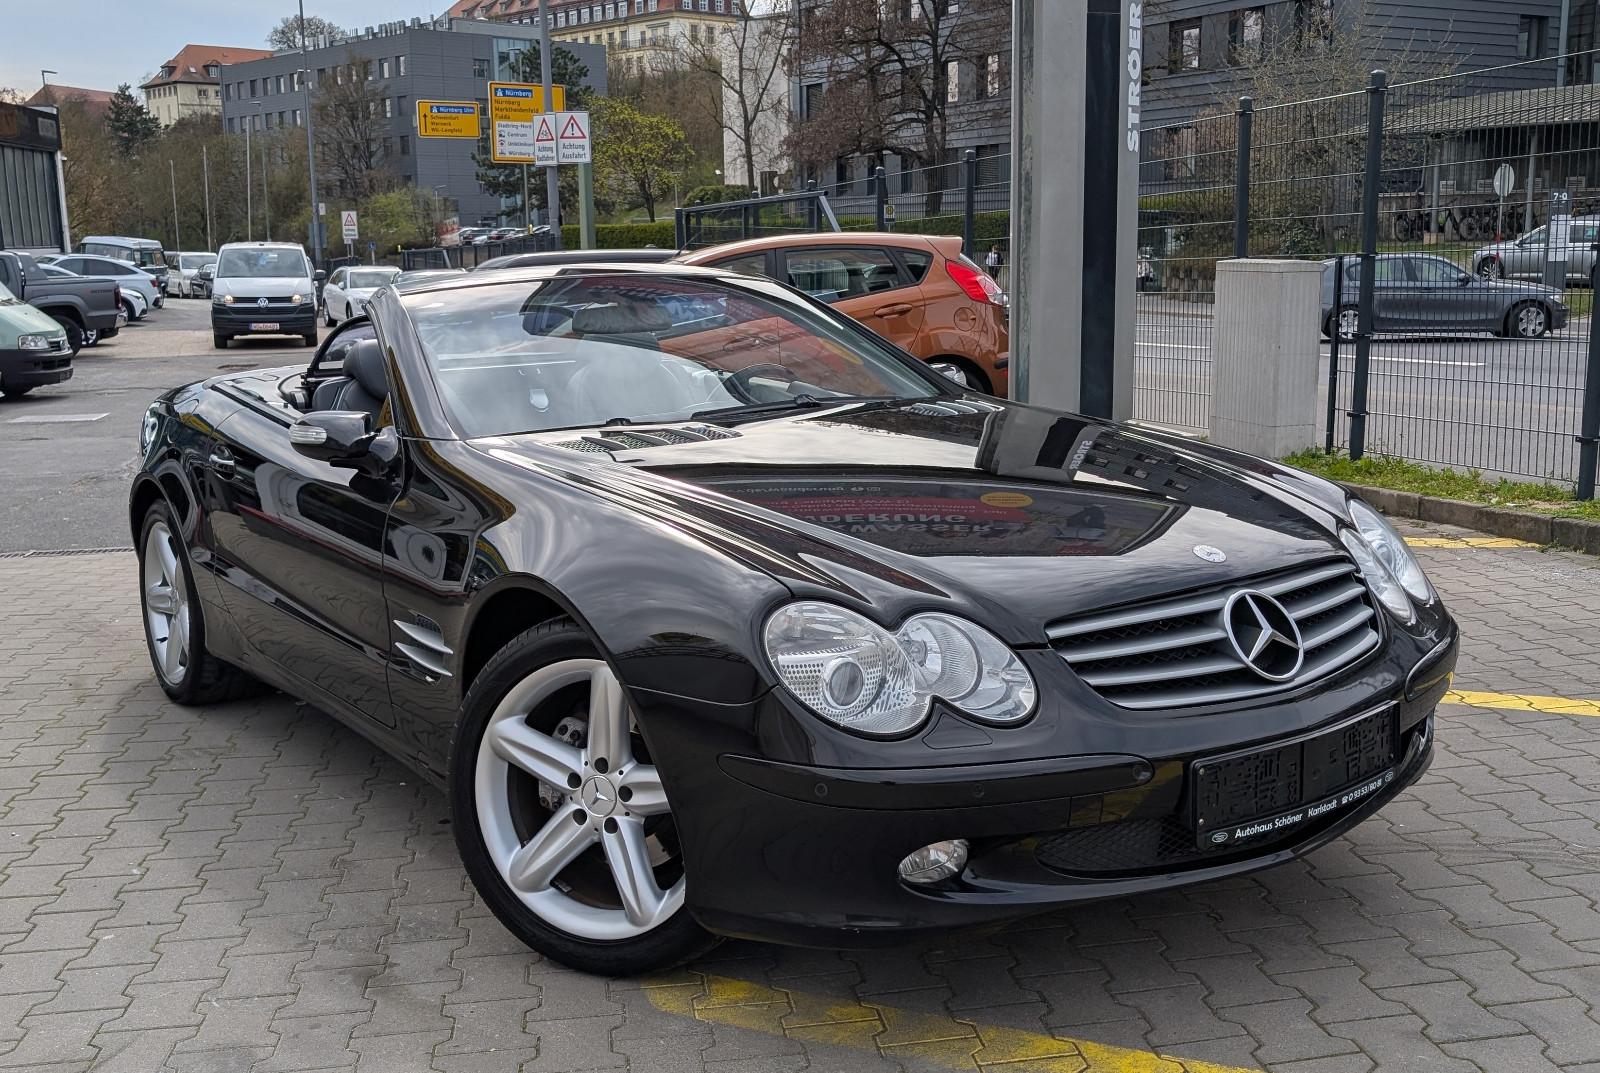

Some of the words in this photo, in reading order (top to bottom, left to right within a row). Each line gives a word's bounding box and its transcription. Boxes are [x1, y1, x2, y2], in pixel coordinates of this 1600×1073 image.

[1127, 3, 1141, 153] STRÖER
[494, 99, 521, 107] Nürnberg
[494, 106, 539, 114] Marktheidenfeld
[538, 145, 554, 153] Achtung
[562, 143, 586, 151] Achtung
[562, 152, 587, 160] Ausfahrt
[1234, 822, 1273, 839] Autohaus
[1274, 812, 1303, 828] Schöner
[1307, 799, 1338, 818] Karlstadt
